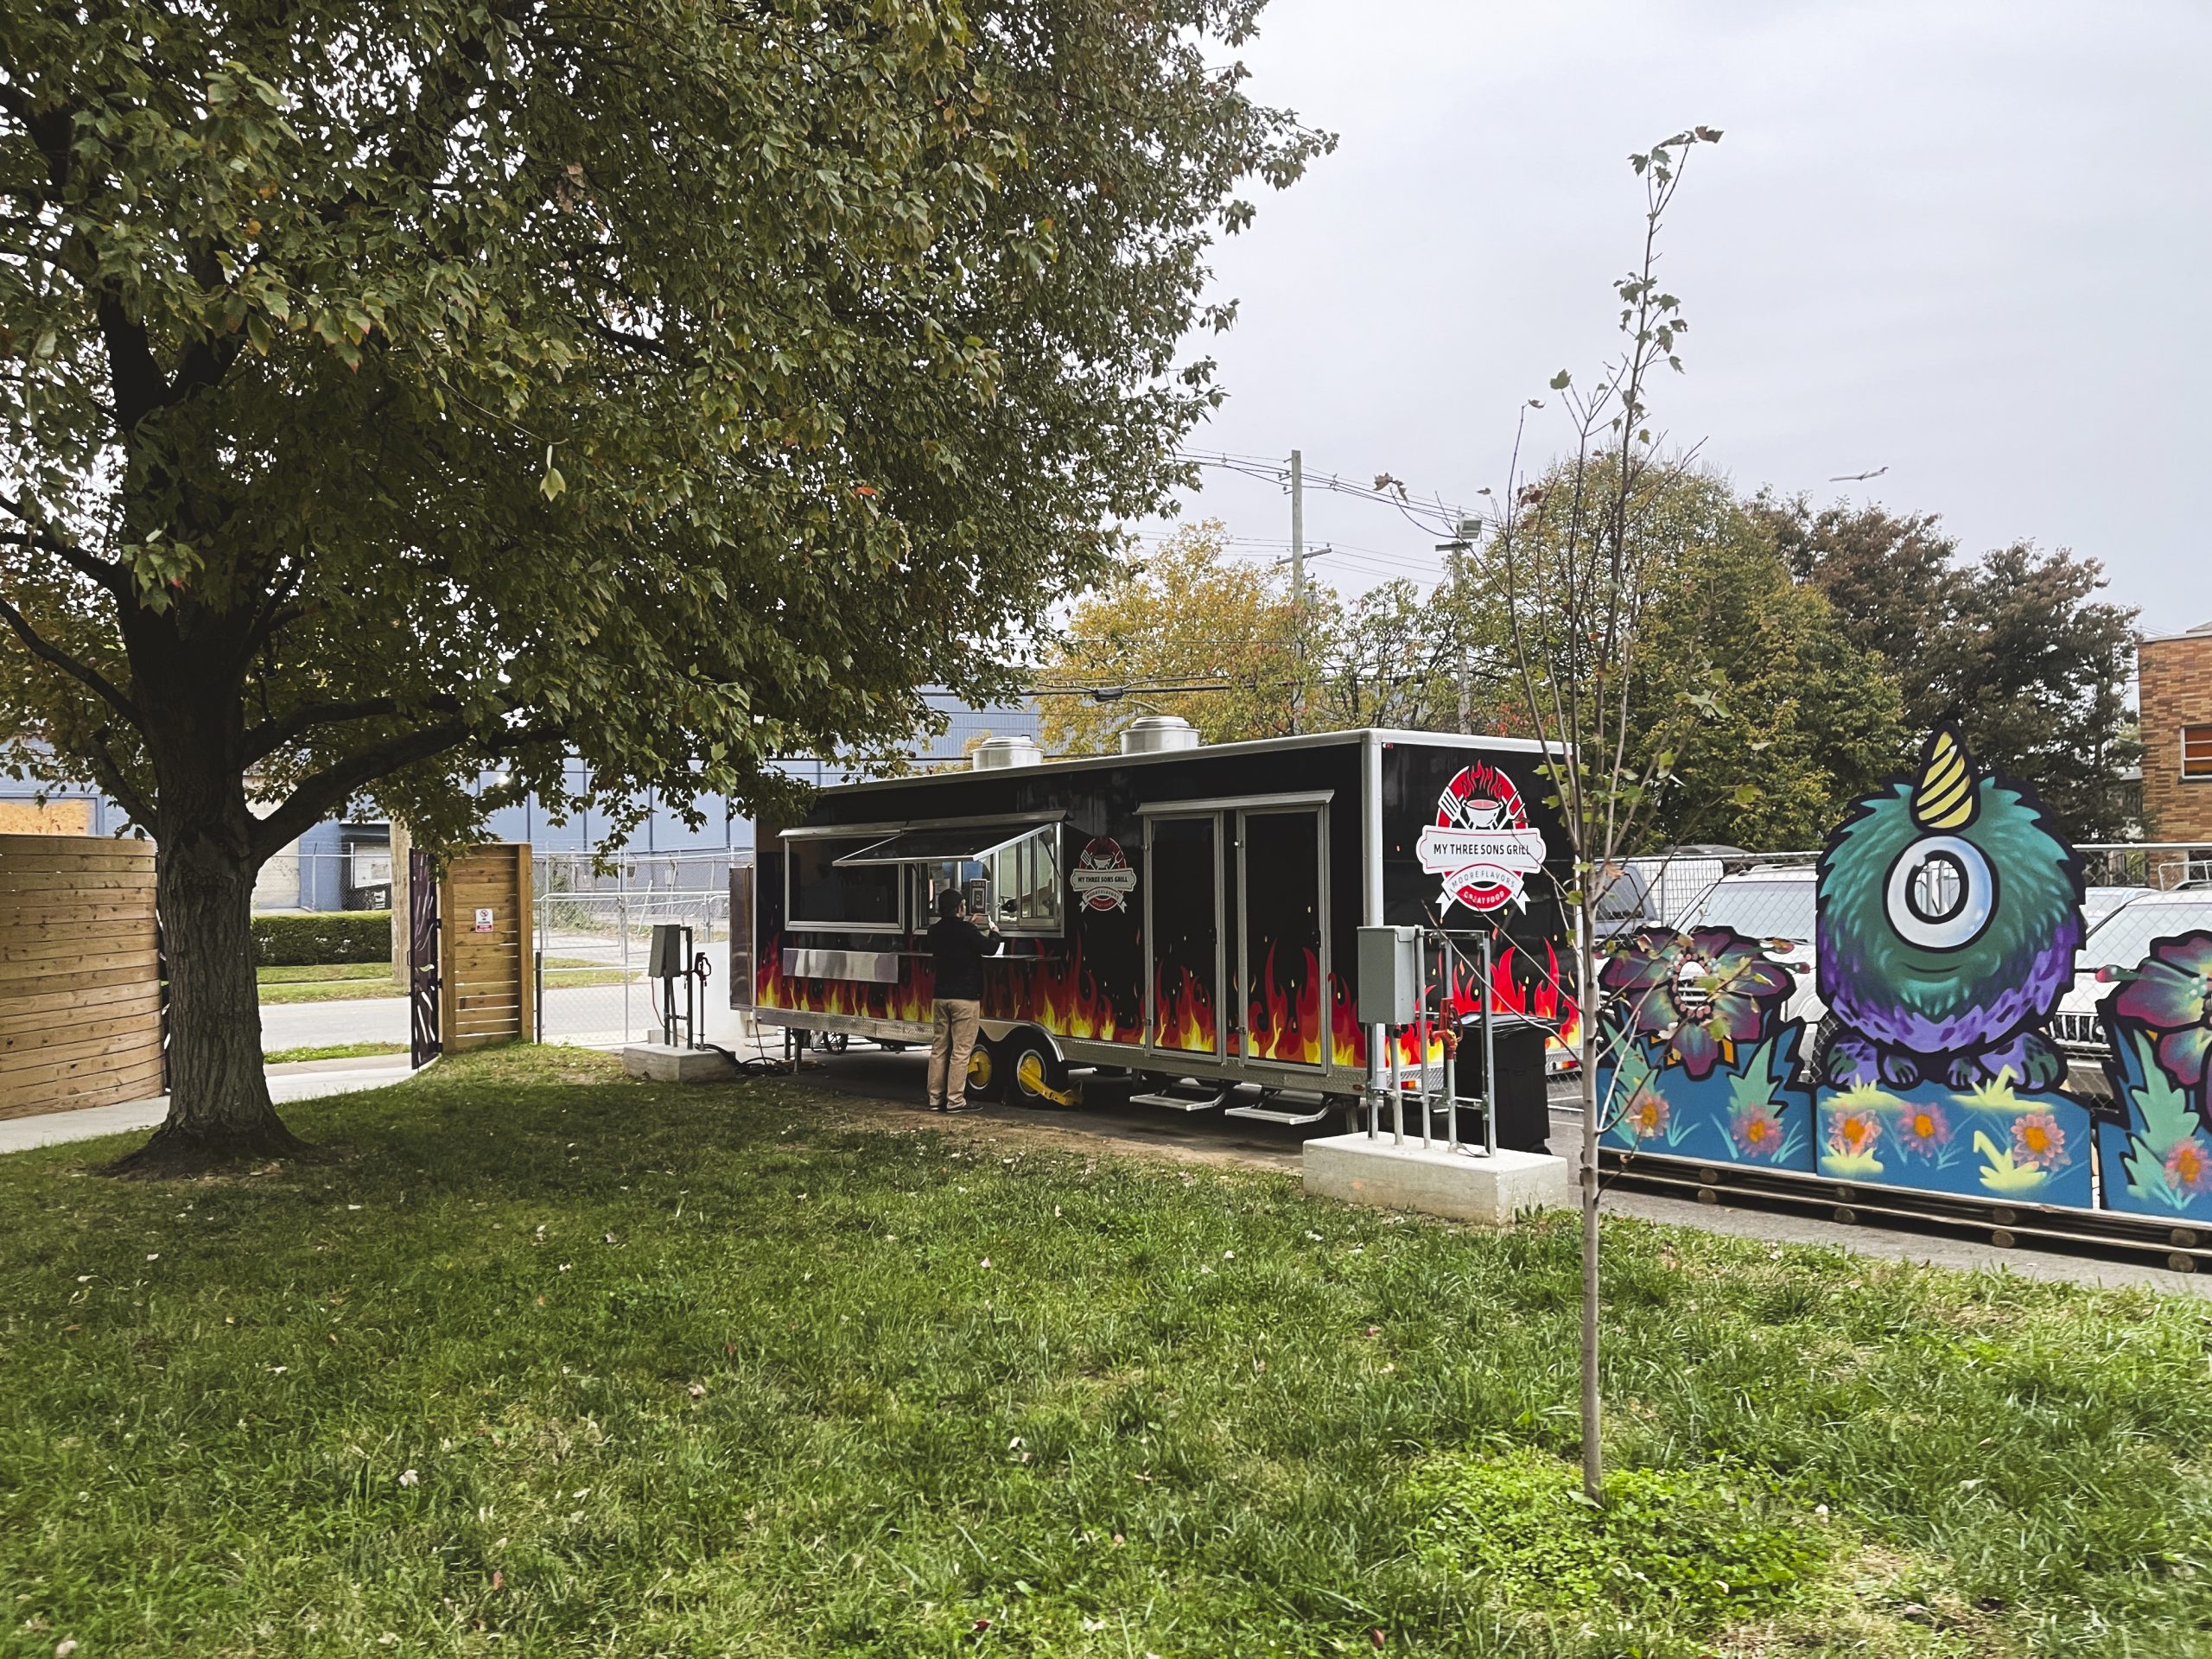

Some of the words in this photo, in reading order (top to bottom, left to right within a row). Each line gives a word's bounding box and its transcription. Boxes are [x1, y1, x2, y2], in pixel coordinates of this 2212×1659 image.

[1433, 843, 1448, 855] MY
[1450, 843, 1478, 855] THREE
[1480, 844, 1504, 855] SONS
[1506, 844, 1529, 855] GRILL
[1486, 890, 1504, 905] FOOD
